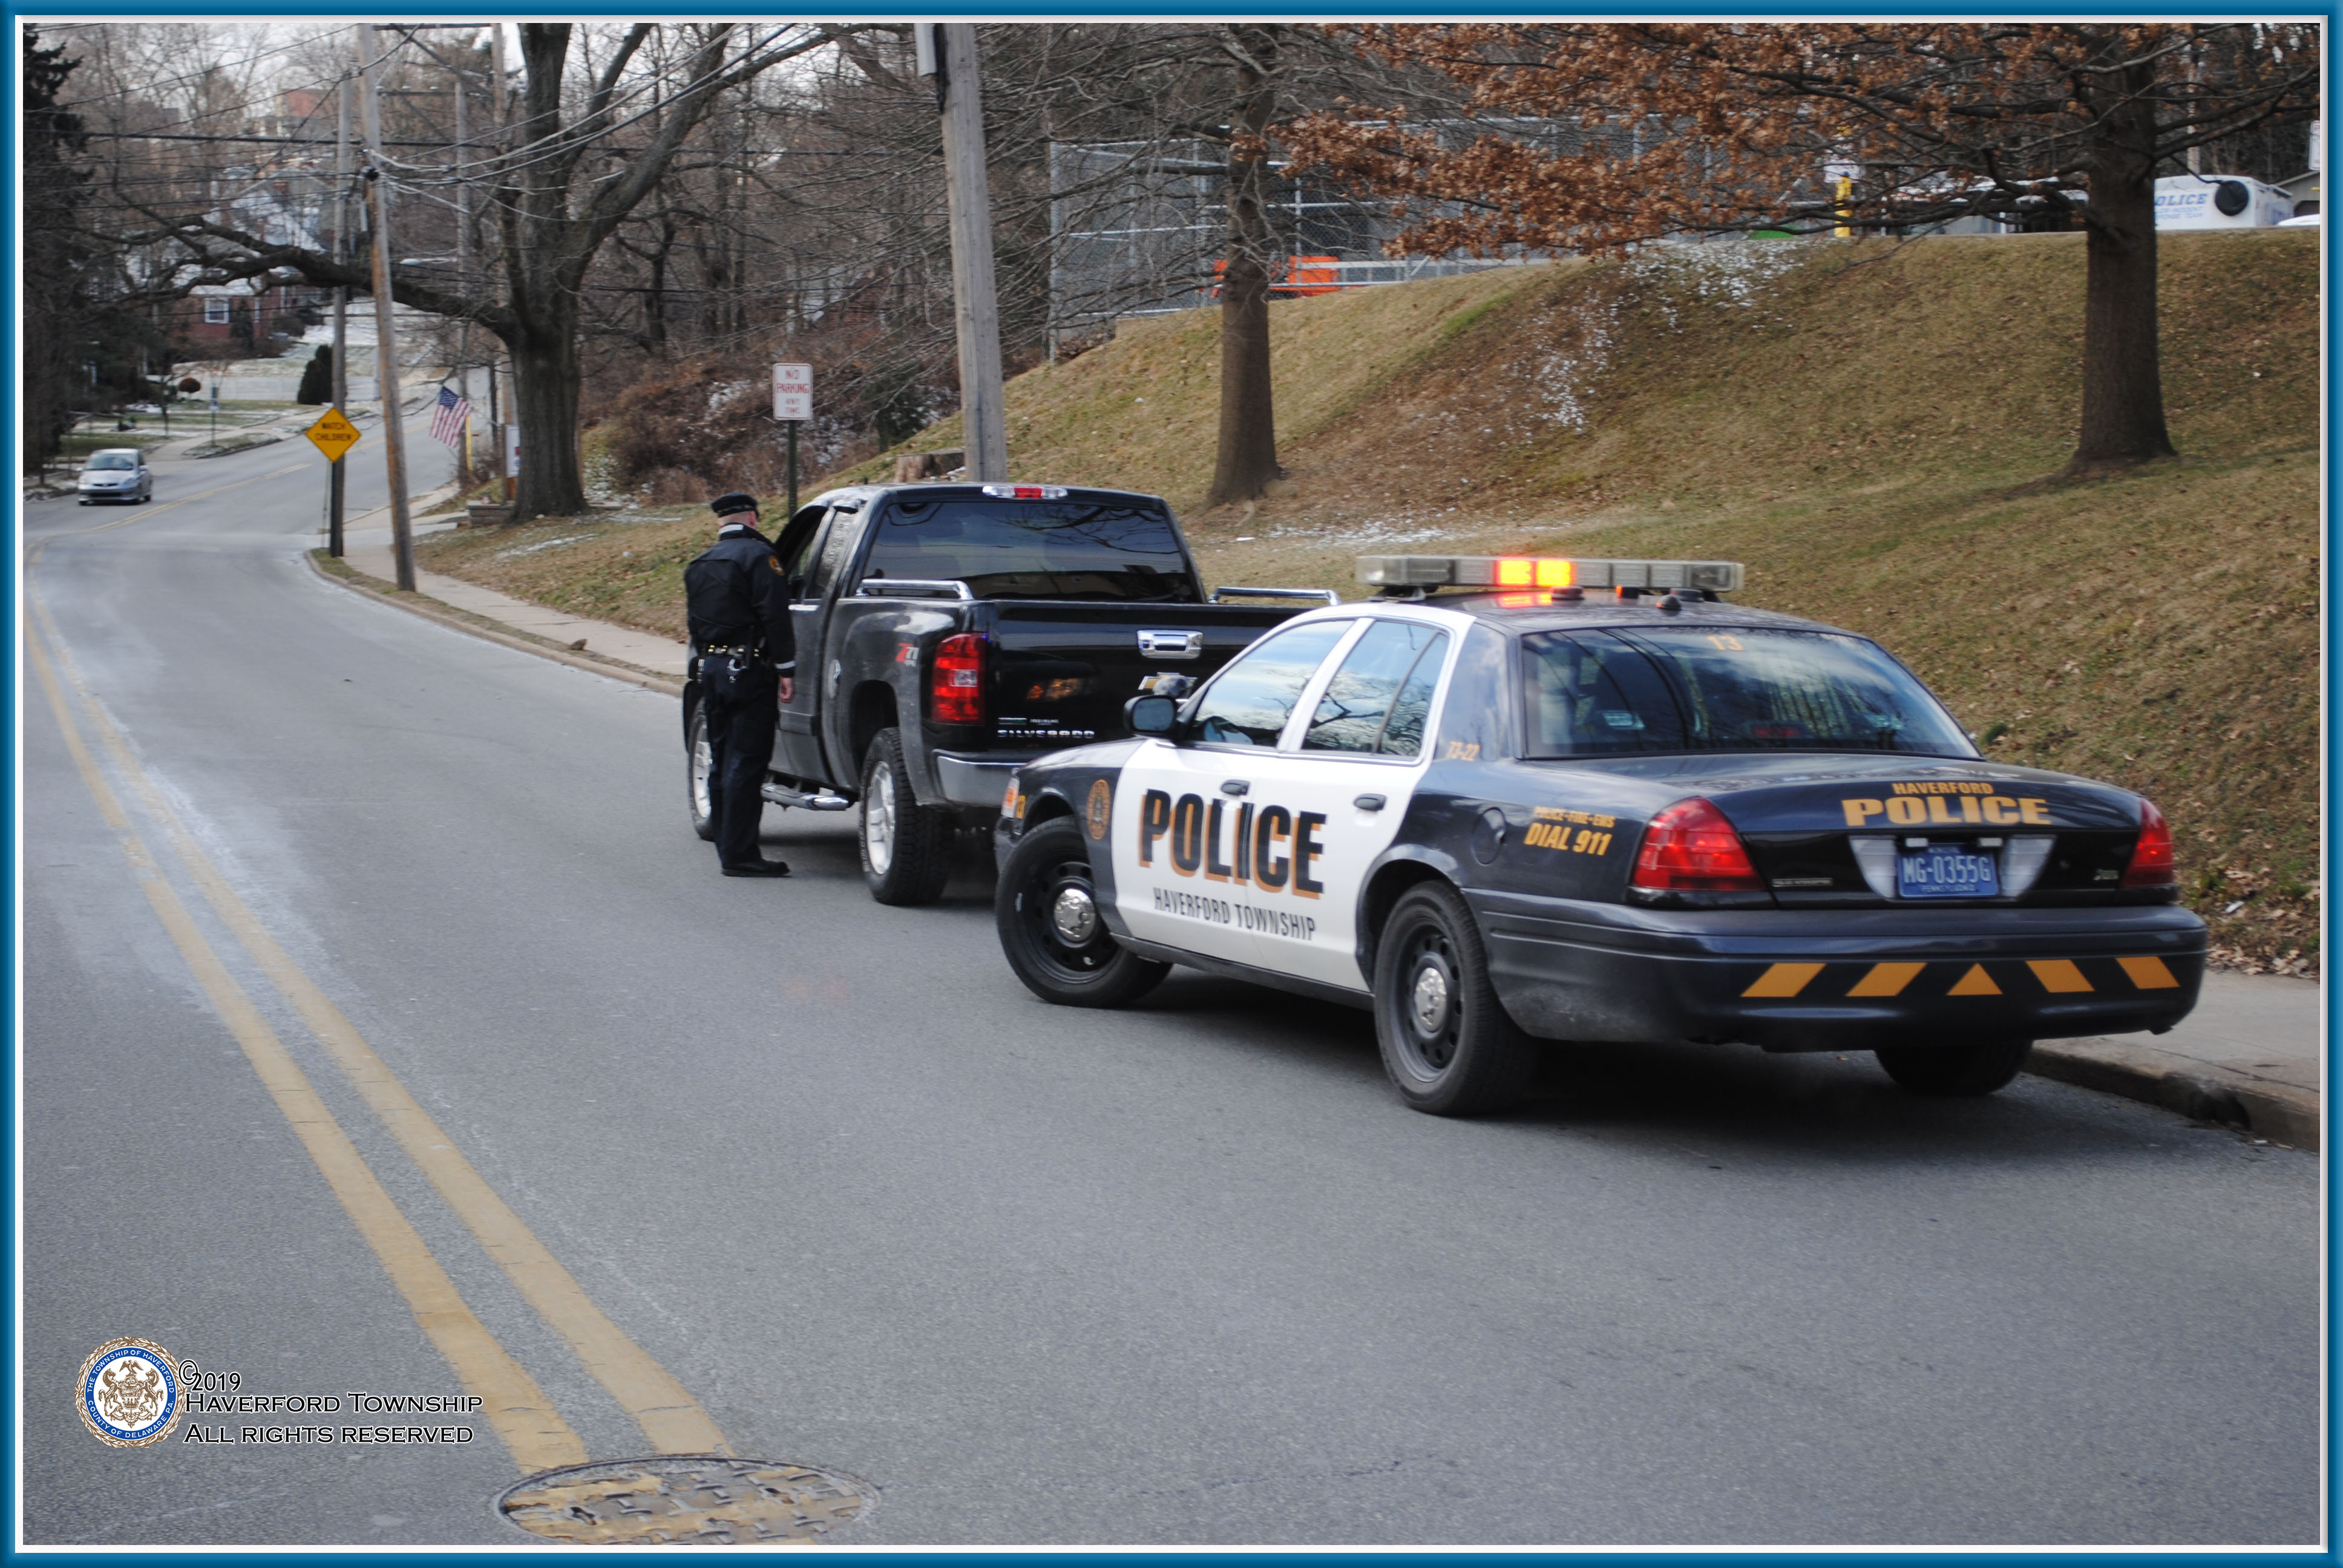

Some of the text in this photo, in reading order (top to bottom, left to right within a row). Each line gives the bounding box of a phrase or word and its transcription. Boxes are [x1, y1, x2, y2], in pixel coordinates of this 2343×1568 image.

[785, 370, 799, 379] NO
[777, 383, 809, 393] PARKING
[315, 433, 352, 441] CHILDREN
[1706, 635, 1743, 650] 13
[1892, 783, 1994, 794] HAVERFORD
[1841, 796, 2051, 826] POLICE
[1139, 788, 1329, 900] POLICE
[1524, 823, 1613, 855] DIAL 911
[1902, 855, 1991, 884] MG-0355G
[1153, 887, 1317, 941] HAVERFORD TOWNSHIP
